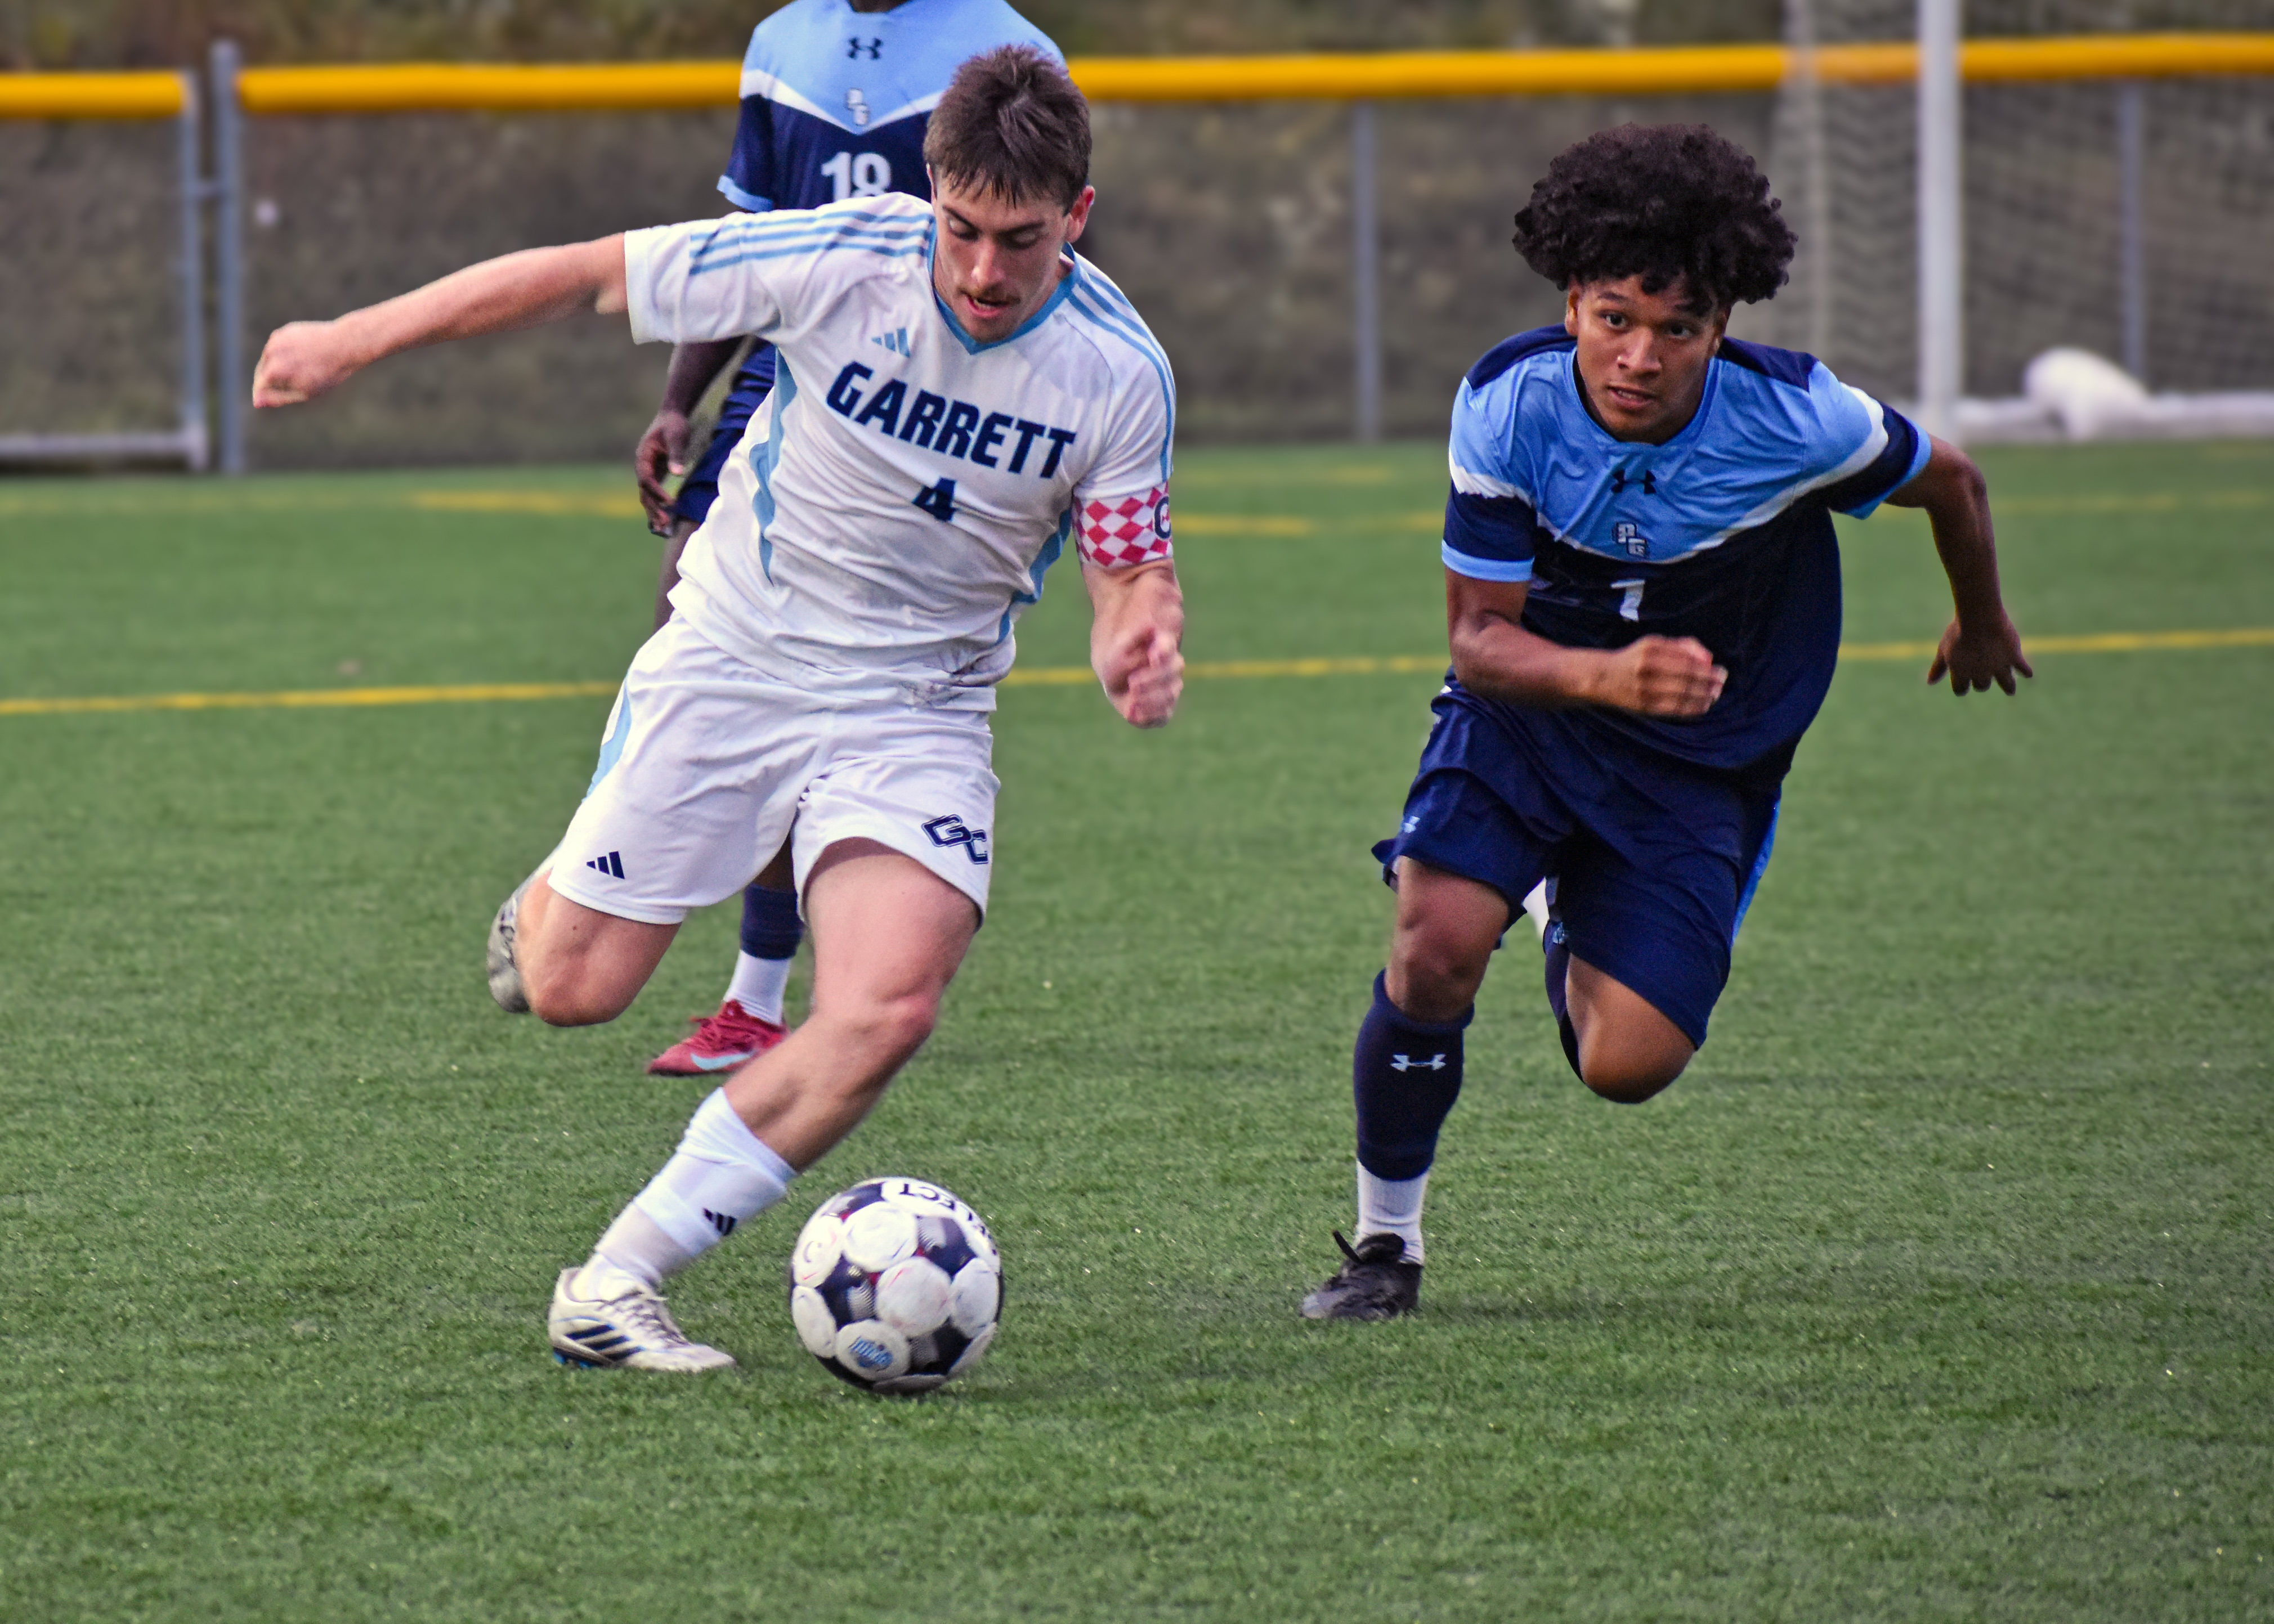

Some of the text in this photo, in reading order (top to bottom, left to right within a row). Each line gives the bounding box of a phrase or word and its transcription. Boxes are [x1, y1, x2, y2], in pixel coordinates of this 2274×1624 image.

[821, 151, 891, 203] 18
[826, 361, 1076, 479] GARRETT
[913, 477, 957, 522] 4
[921, 814, 989, 865] GC
